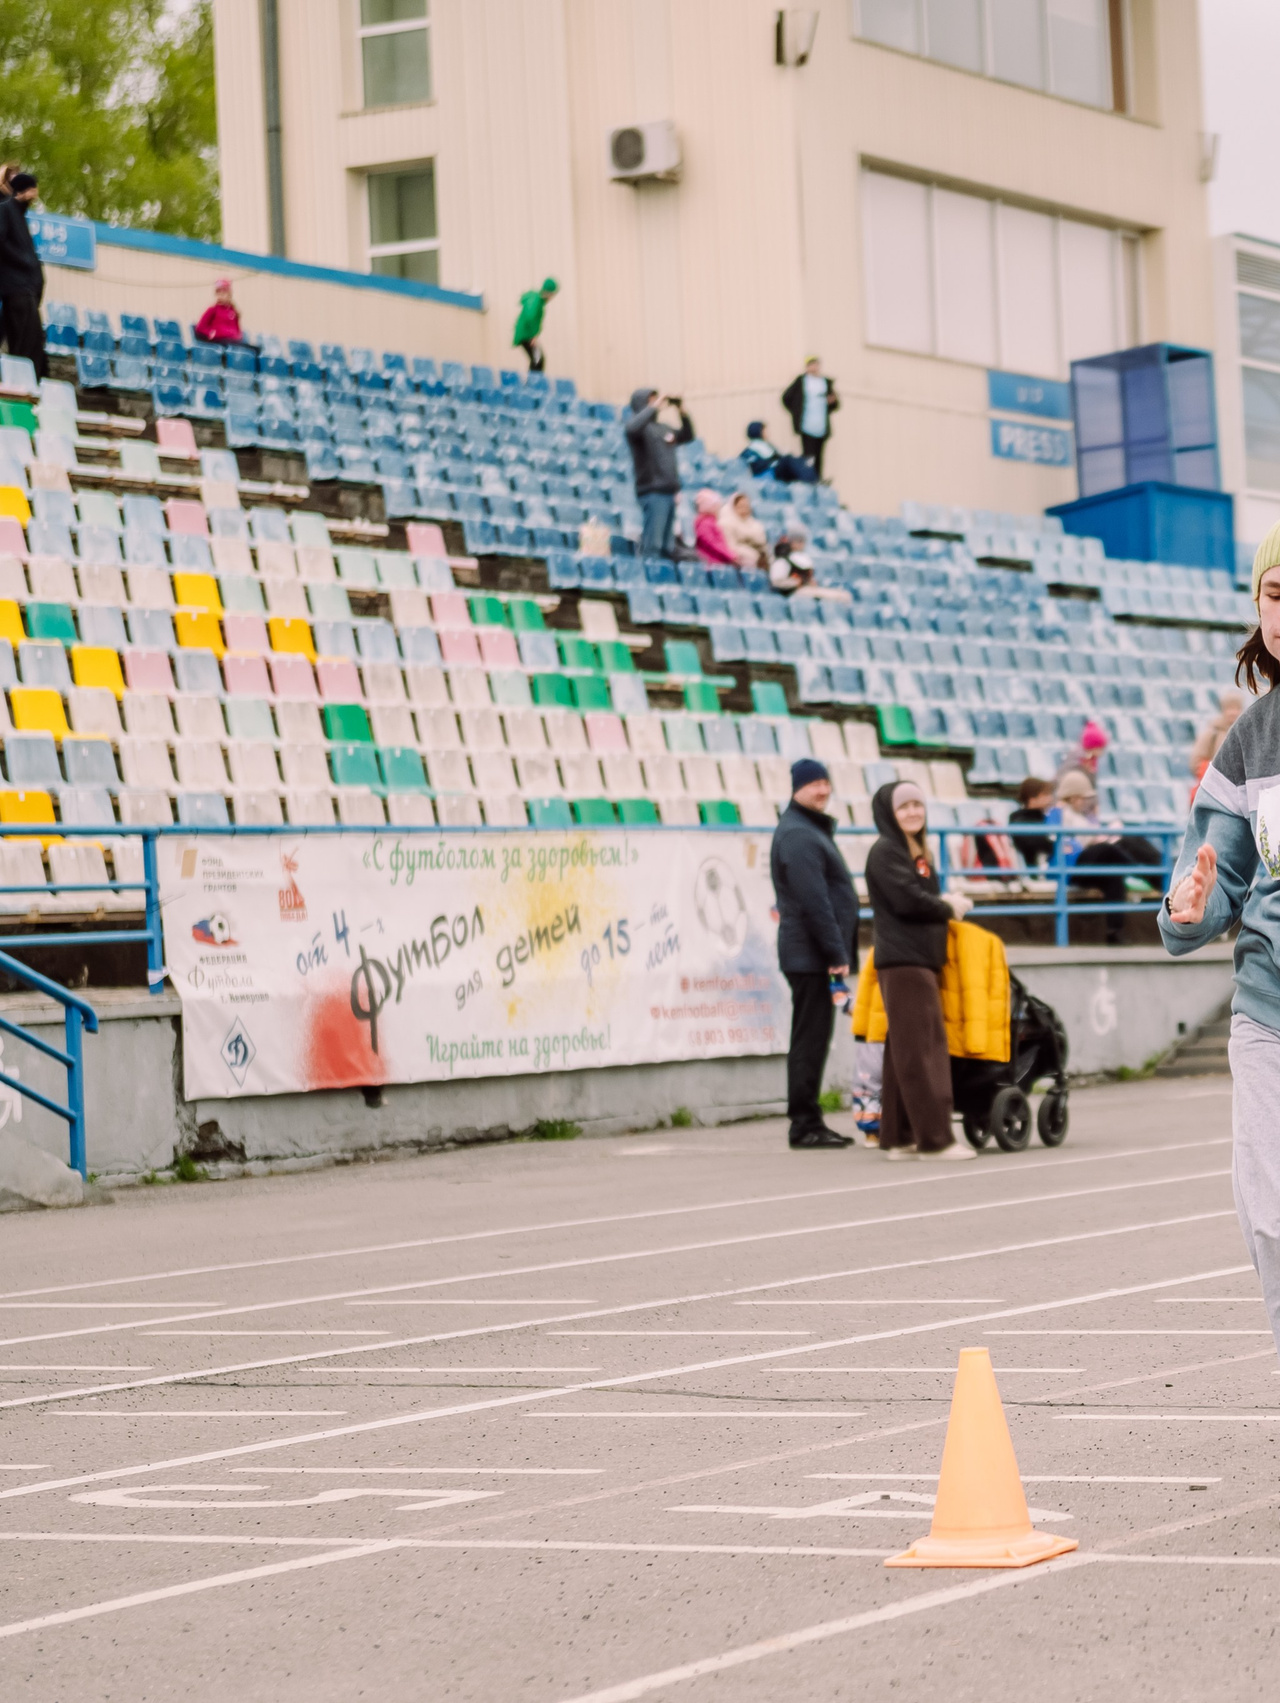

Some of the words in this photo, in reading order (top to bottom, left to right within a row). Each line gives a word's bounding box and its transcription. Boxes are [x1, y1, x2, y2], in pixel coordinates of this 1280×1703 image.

[999, 424, 1066, 462] PRESS
[389, 840, 497, 887] футболом
[501, 852, 522, 884] за
[296, 931, 328, 976] от
[455, 970, 483, 1011] для
[496, 903, 582, 988] детей
[581, 943, 600, 988] до
[645, 922, 681, 972] лет
[426, 1032, 503, 1074] Играйте
[508, 1036, 530, 1057] на
[534, 1023, 612, 1068] здоровье!
